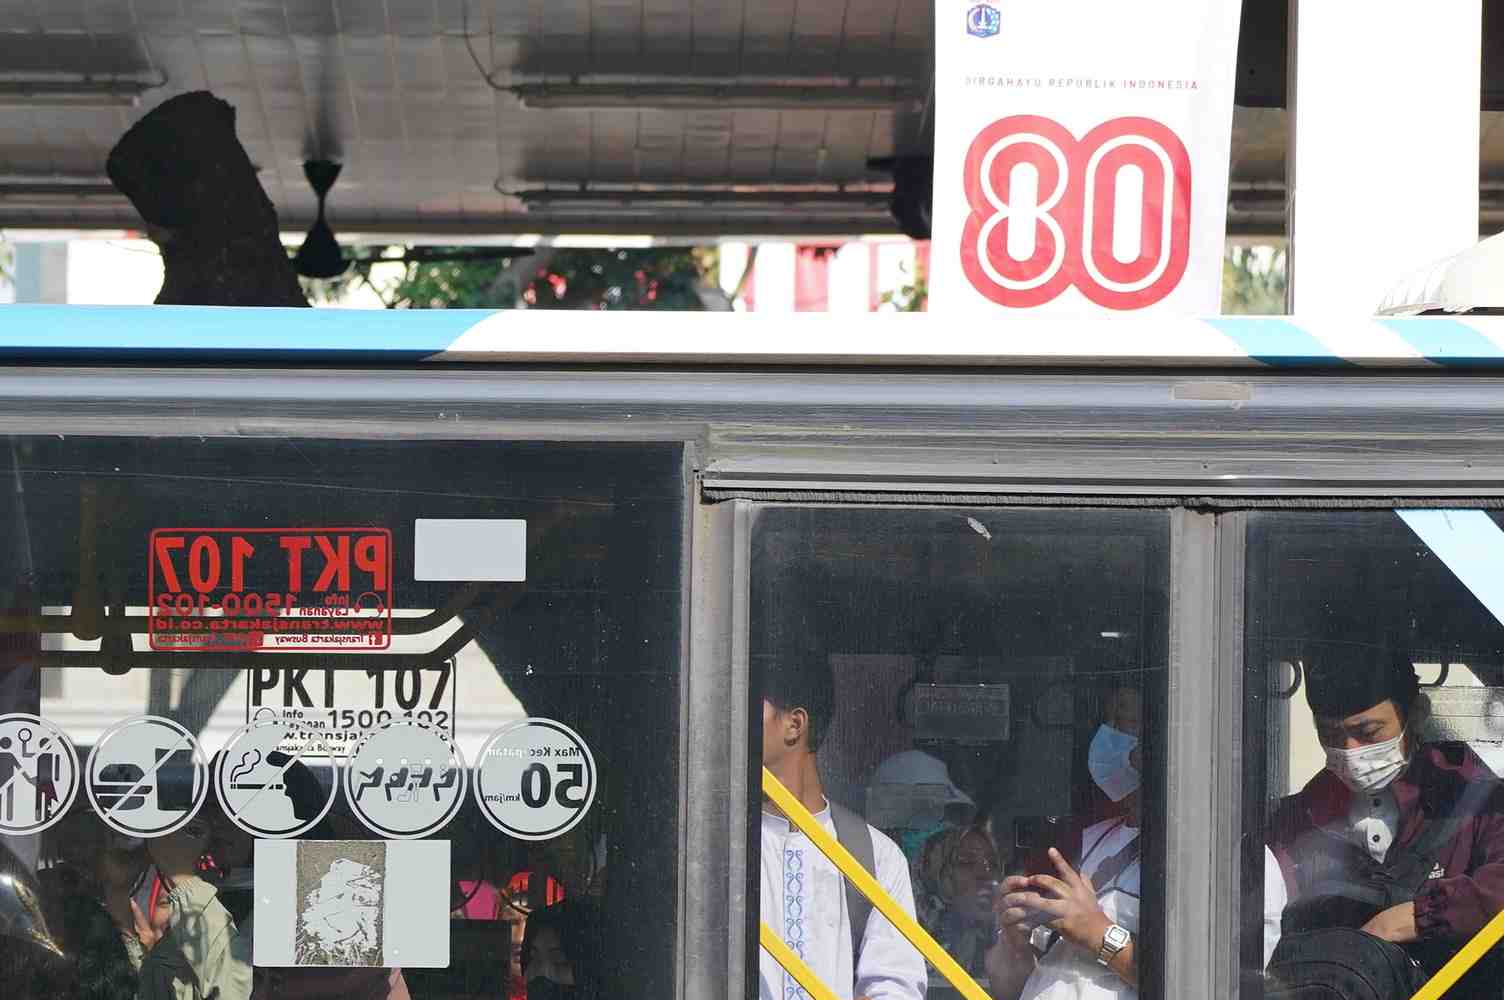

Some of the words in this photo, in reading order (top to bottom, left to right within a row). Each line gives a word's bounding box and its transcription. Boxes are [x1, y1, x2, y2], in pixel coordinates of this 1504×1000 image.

[965, 76, 1041, 87] DIRGAHAYU
[1048, 78, 1117, 89] REPUBLIK
[1122, 79, 1198, 90] INDONESIA
[960, 114, 1192, 311] 80
[366, 662, 452, 710] 107
